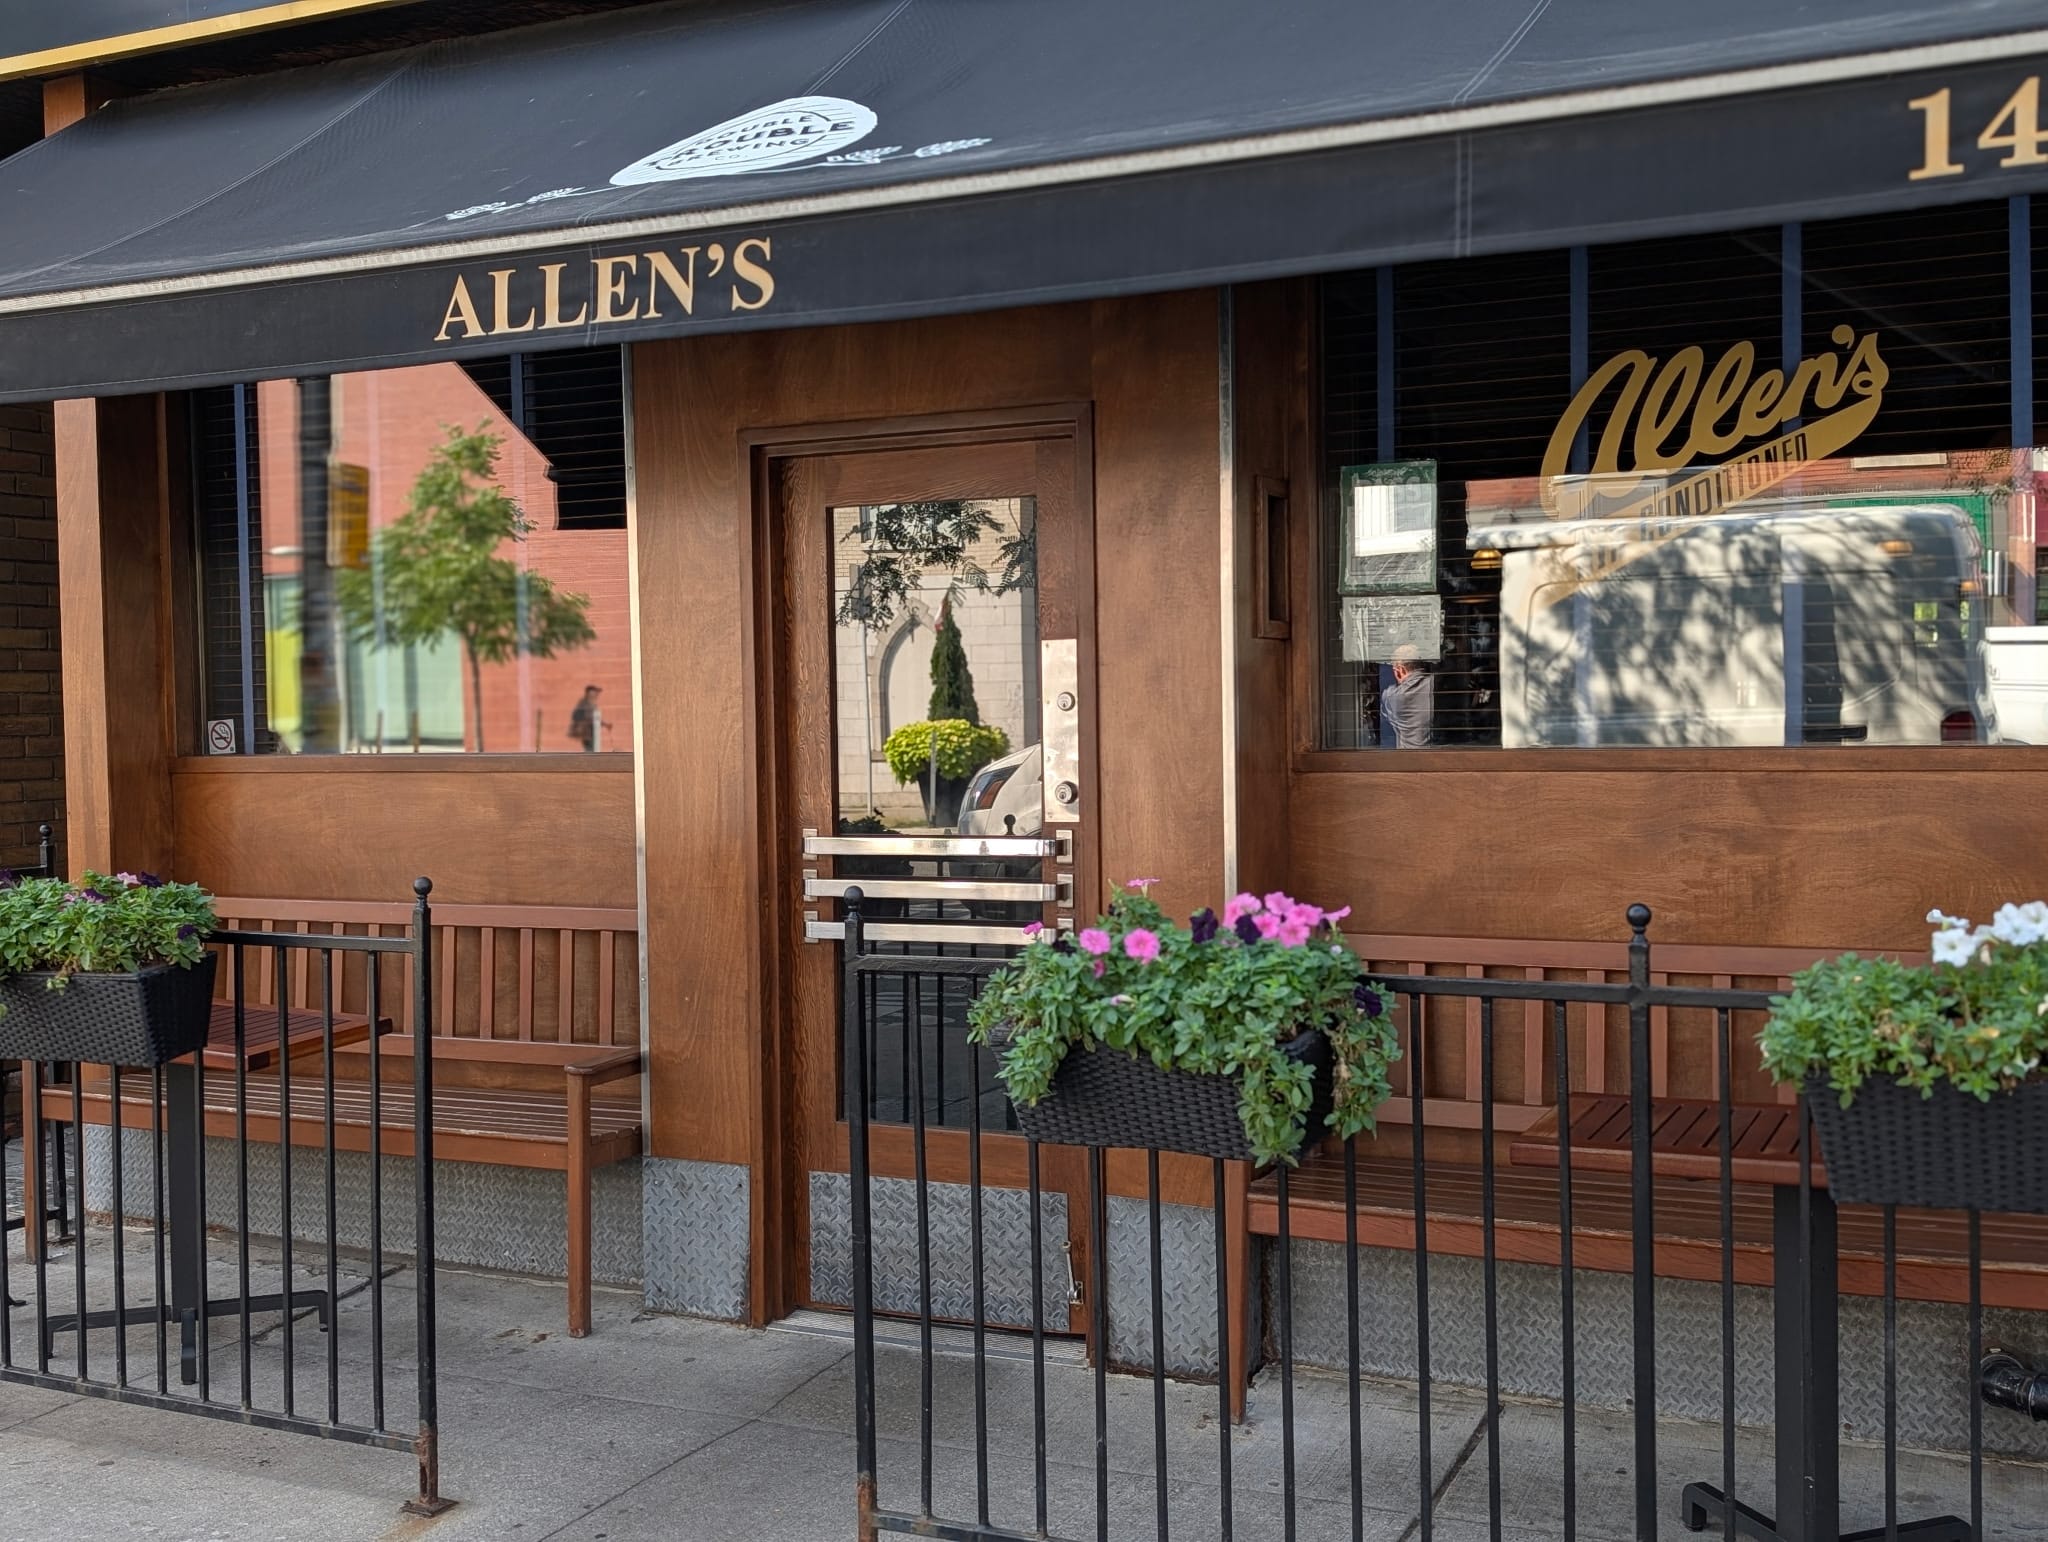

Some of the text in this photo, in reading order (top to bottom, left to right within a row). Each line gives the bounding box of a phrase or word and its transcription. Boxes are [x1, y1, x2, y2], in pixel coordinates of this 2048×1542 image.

[643, 121, 855, 167] TROUBLE
[667, 138, 809, 166] BREWING
[696, 115, 813, 146] DOUBLE
[1908, 76, 2048, 180] 14
[434, 237, 776, 341] ALLEN'S
[1540, 324, 1889, 519] Allen's
[1640, 432, 1808, 542] CONDITIONED
